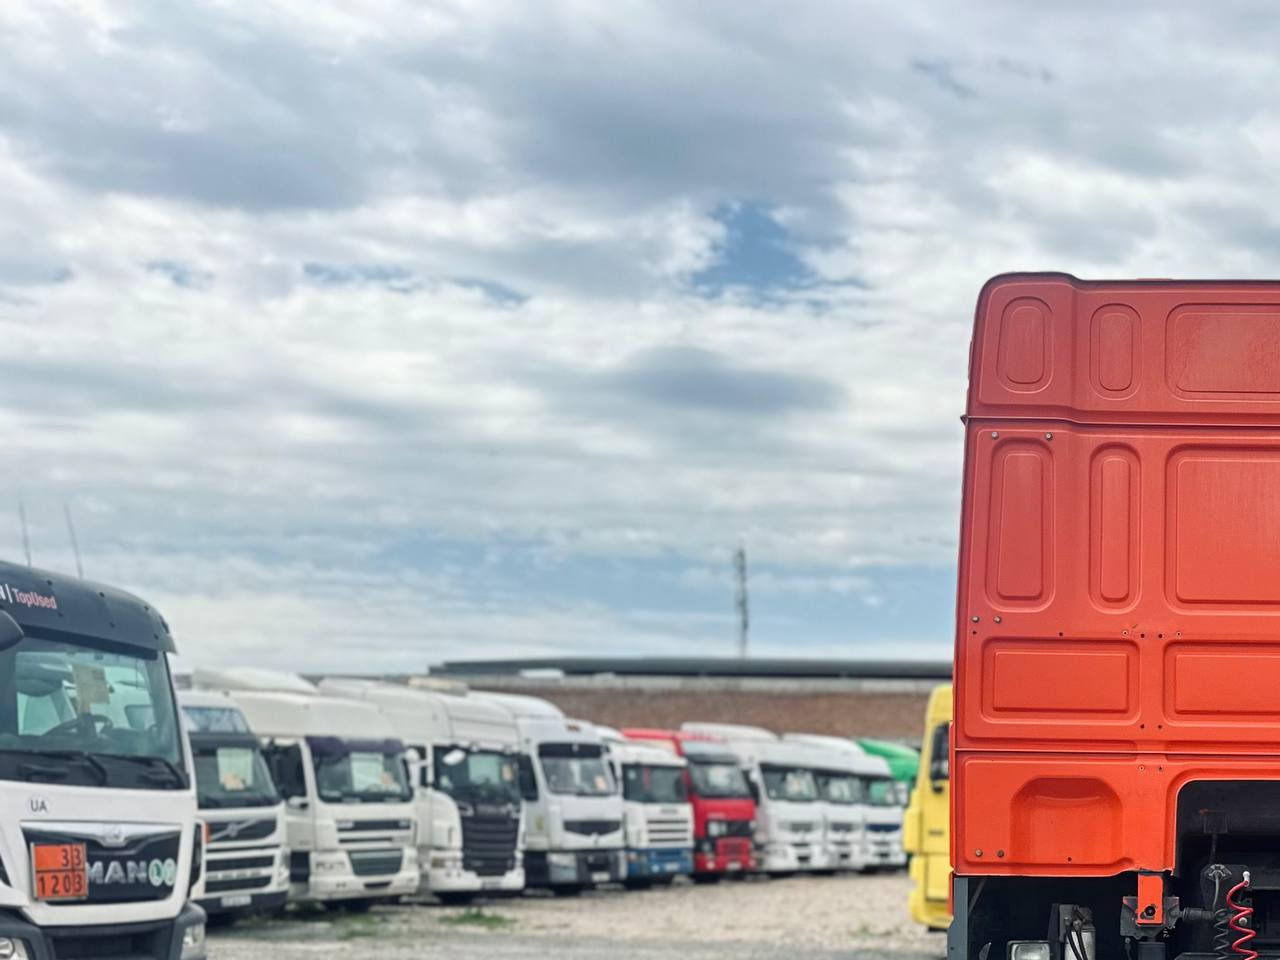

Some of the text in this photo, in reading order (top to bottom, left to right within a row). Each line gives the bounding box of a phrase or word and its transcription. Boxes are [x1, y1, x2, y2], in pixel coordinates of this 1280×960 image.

[12, 587, 57, 610] TopUsed
[30, 799, 48, 813] UA
[62, 848, 83, 869] 33
[87, 860, 148, 885] MAN
[38, 873, 84, 896] 1203
